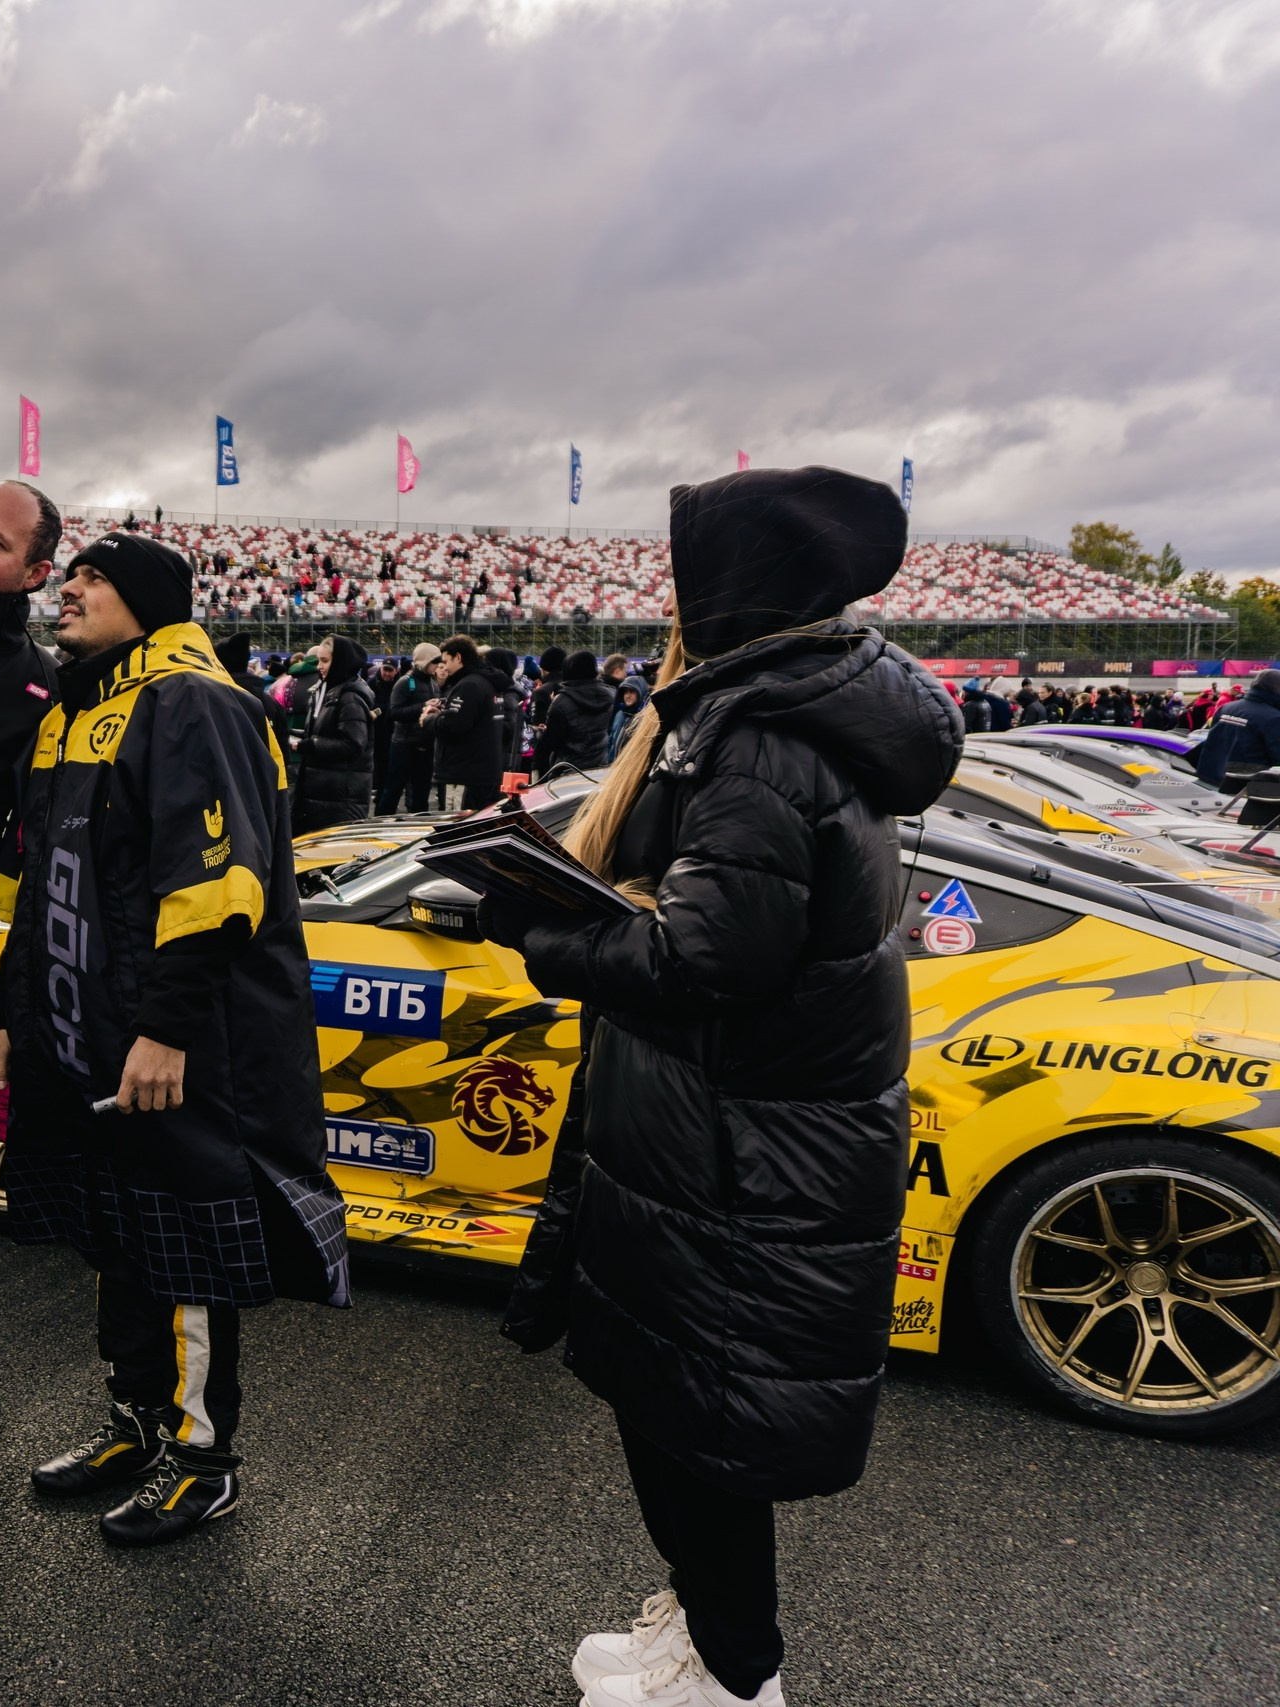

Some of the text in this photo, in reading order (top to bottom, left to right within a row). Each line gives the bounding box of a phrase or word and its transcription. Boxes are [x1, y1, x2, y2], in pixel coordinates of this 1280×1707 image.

[96, 722, 119, 745] 31
[344, 977, 426, 1021] ВТБ
[1036, 1040, 1272, 1088] LINGLONG
[386, 1210, 459, 1230] АВТО
